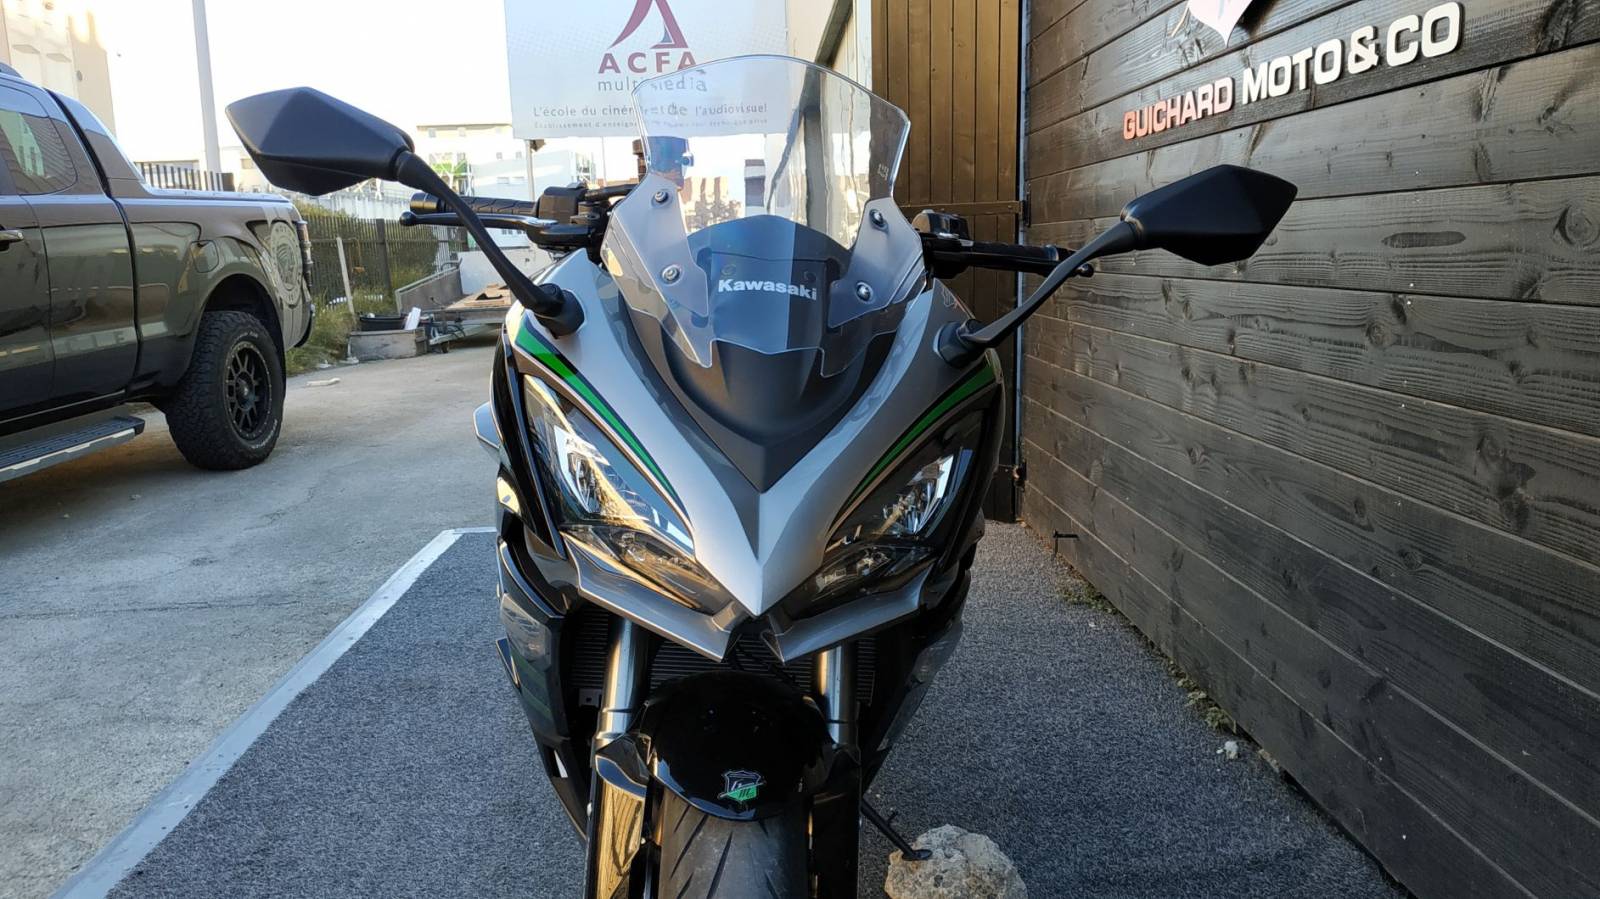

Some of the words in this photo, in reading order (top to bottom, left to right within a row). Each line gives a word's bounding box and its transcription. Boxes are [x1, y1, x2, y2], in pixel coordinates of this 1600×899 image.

[598, 51, 703, 74] ACFA
[598, 76, 707, 92] multedia
[533, 105, 577, 117] L'école
[582, 104, 597, 116] du
[602, 104, 648, 116] ciné
[695, 103, 768, 116] l'audiovisuel
[1123, 76, 1235, 140] GUICHARD
[718, 278, 817, 301] Kawasaki
